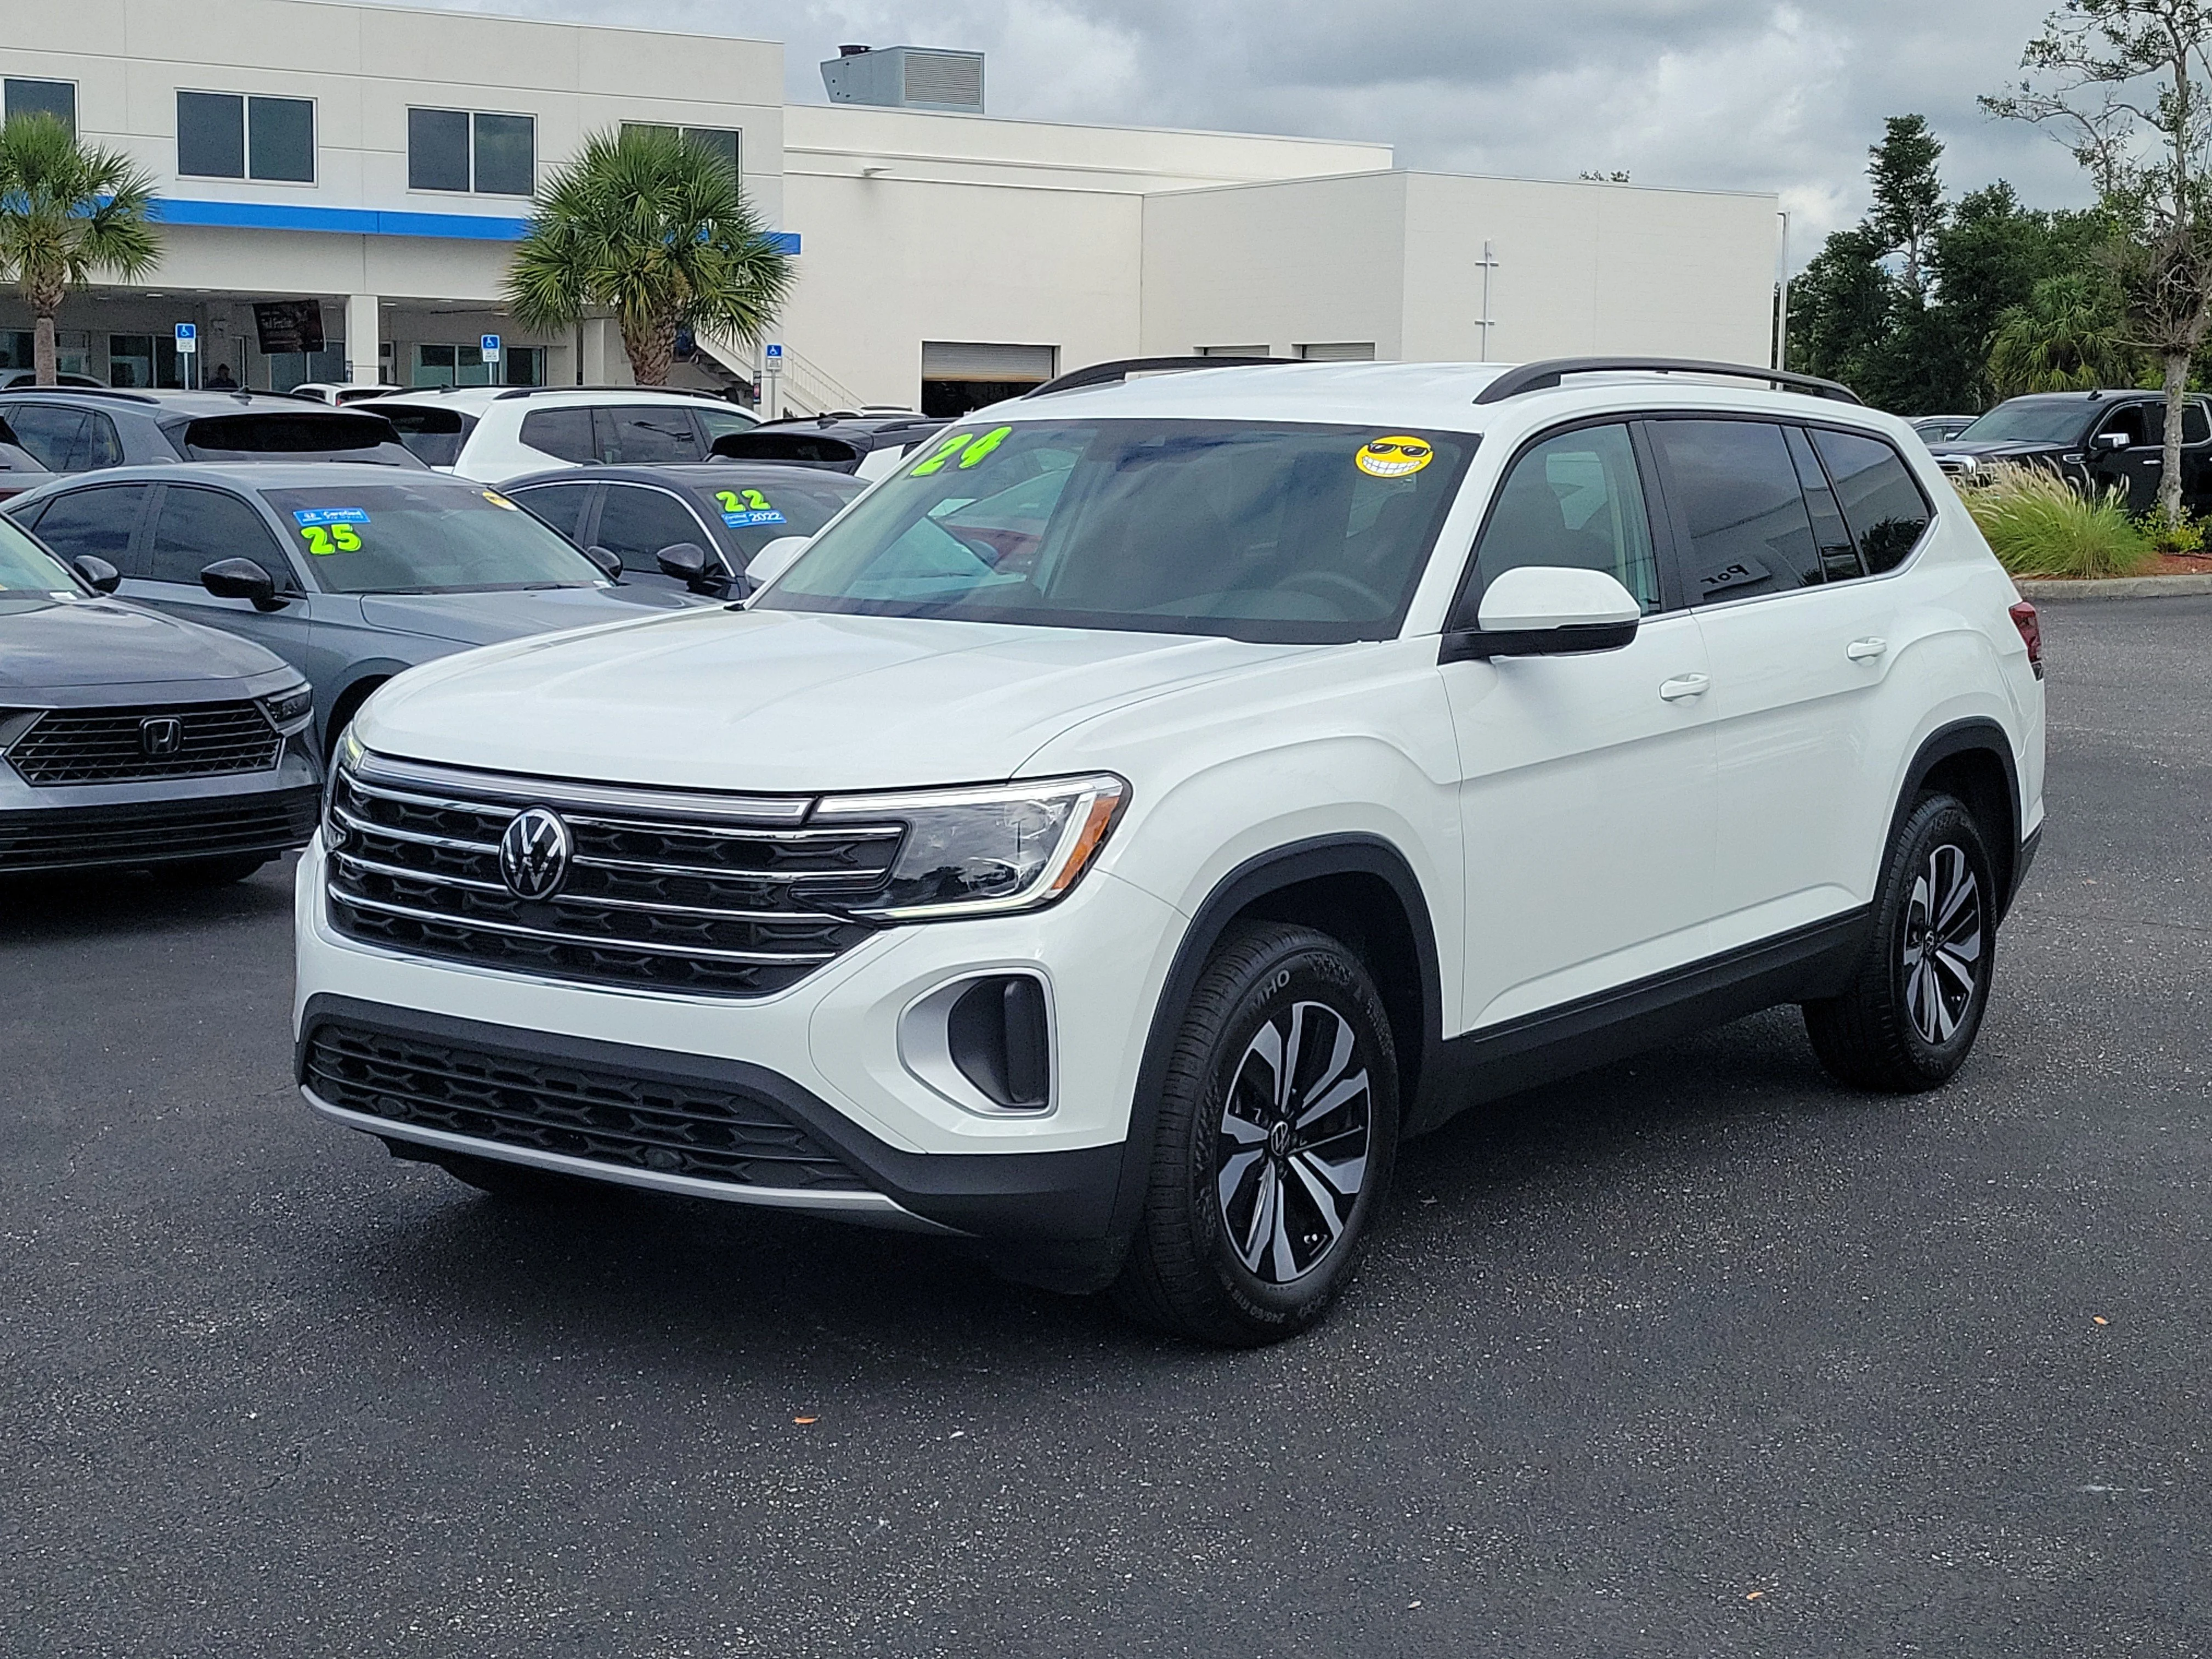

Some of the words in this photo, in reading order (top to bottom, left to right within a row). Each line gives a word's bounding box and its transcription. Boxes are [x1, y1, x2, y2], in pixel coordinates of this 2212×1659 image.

[910, 426, 1012, 477] 24
[715, 489, 771, 512] 22
[749, 512, 782, 522] 2022
[301, 523, 362, 555] 25
